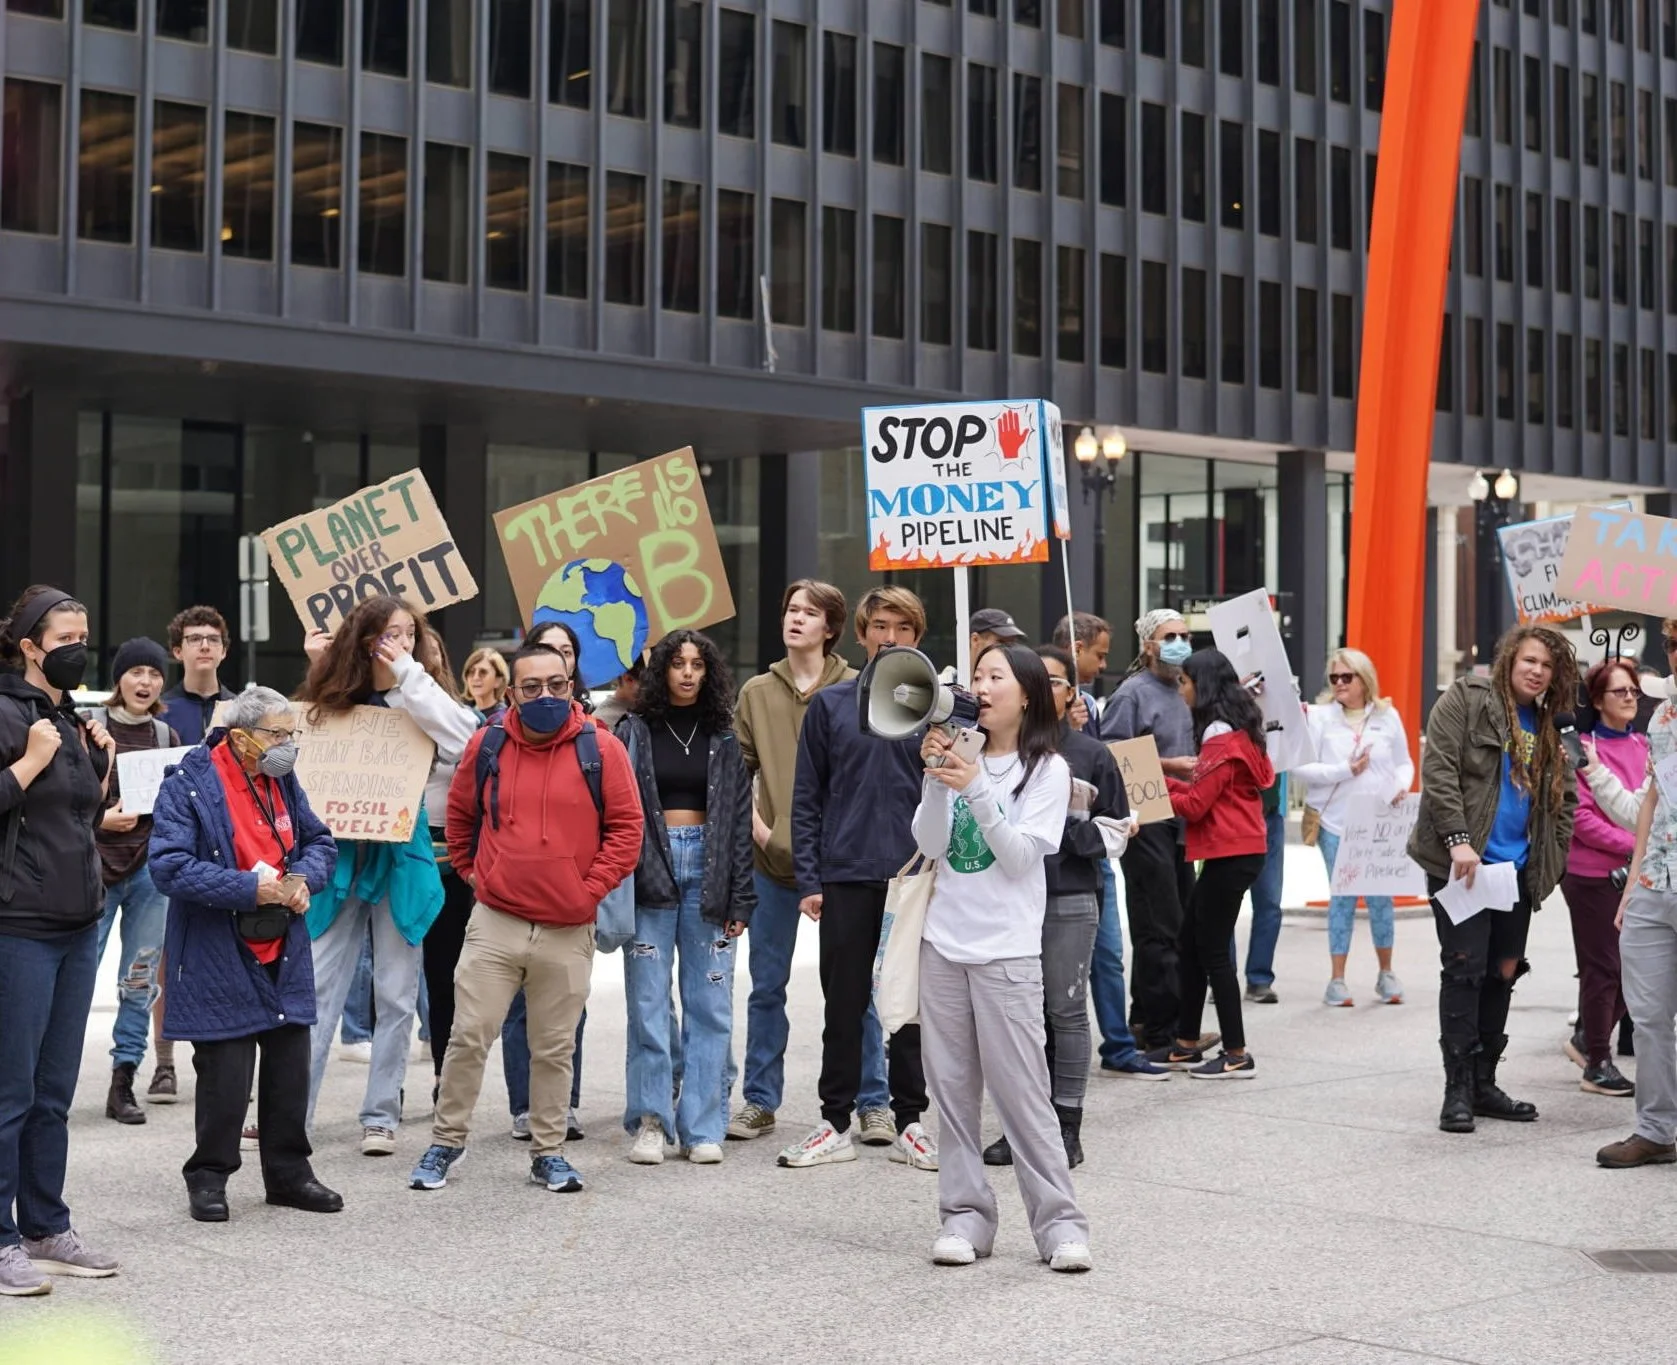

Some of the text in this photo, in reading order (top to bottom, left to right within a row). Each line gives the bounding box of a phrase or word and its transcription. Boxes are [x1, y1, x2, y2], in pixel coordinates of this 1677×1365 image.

[871, 415, 987, 463] STOP
[932, 462, 972, 477] THE
[504, 457, 696, 567] THERE IS
[653, 491, 698, 531] NO
[868, 480, 1040, 518] MONEY
[276, 476, 419, 579] PLANET
[901, 516, 1014, 548] PIPELINE
[331, 541, 389, 582] OVER
[638, 529, 713, 633] B
[1523, 592, 1582, 612] CLIMA
[350, 711, 402, 737] WE
[299, 739, 352, 766] THAT
[305, 771, 407, 799] SPENDING
[325, 800, 389, 816] FOSSIL
[325, 818, 389, 834] FUELS
[964, 860, 983, 870] U.S.
